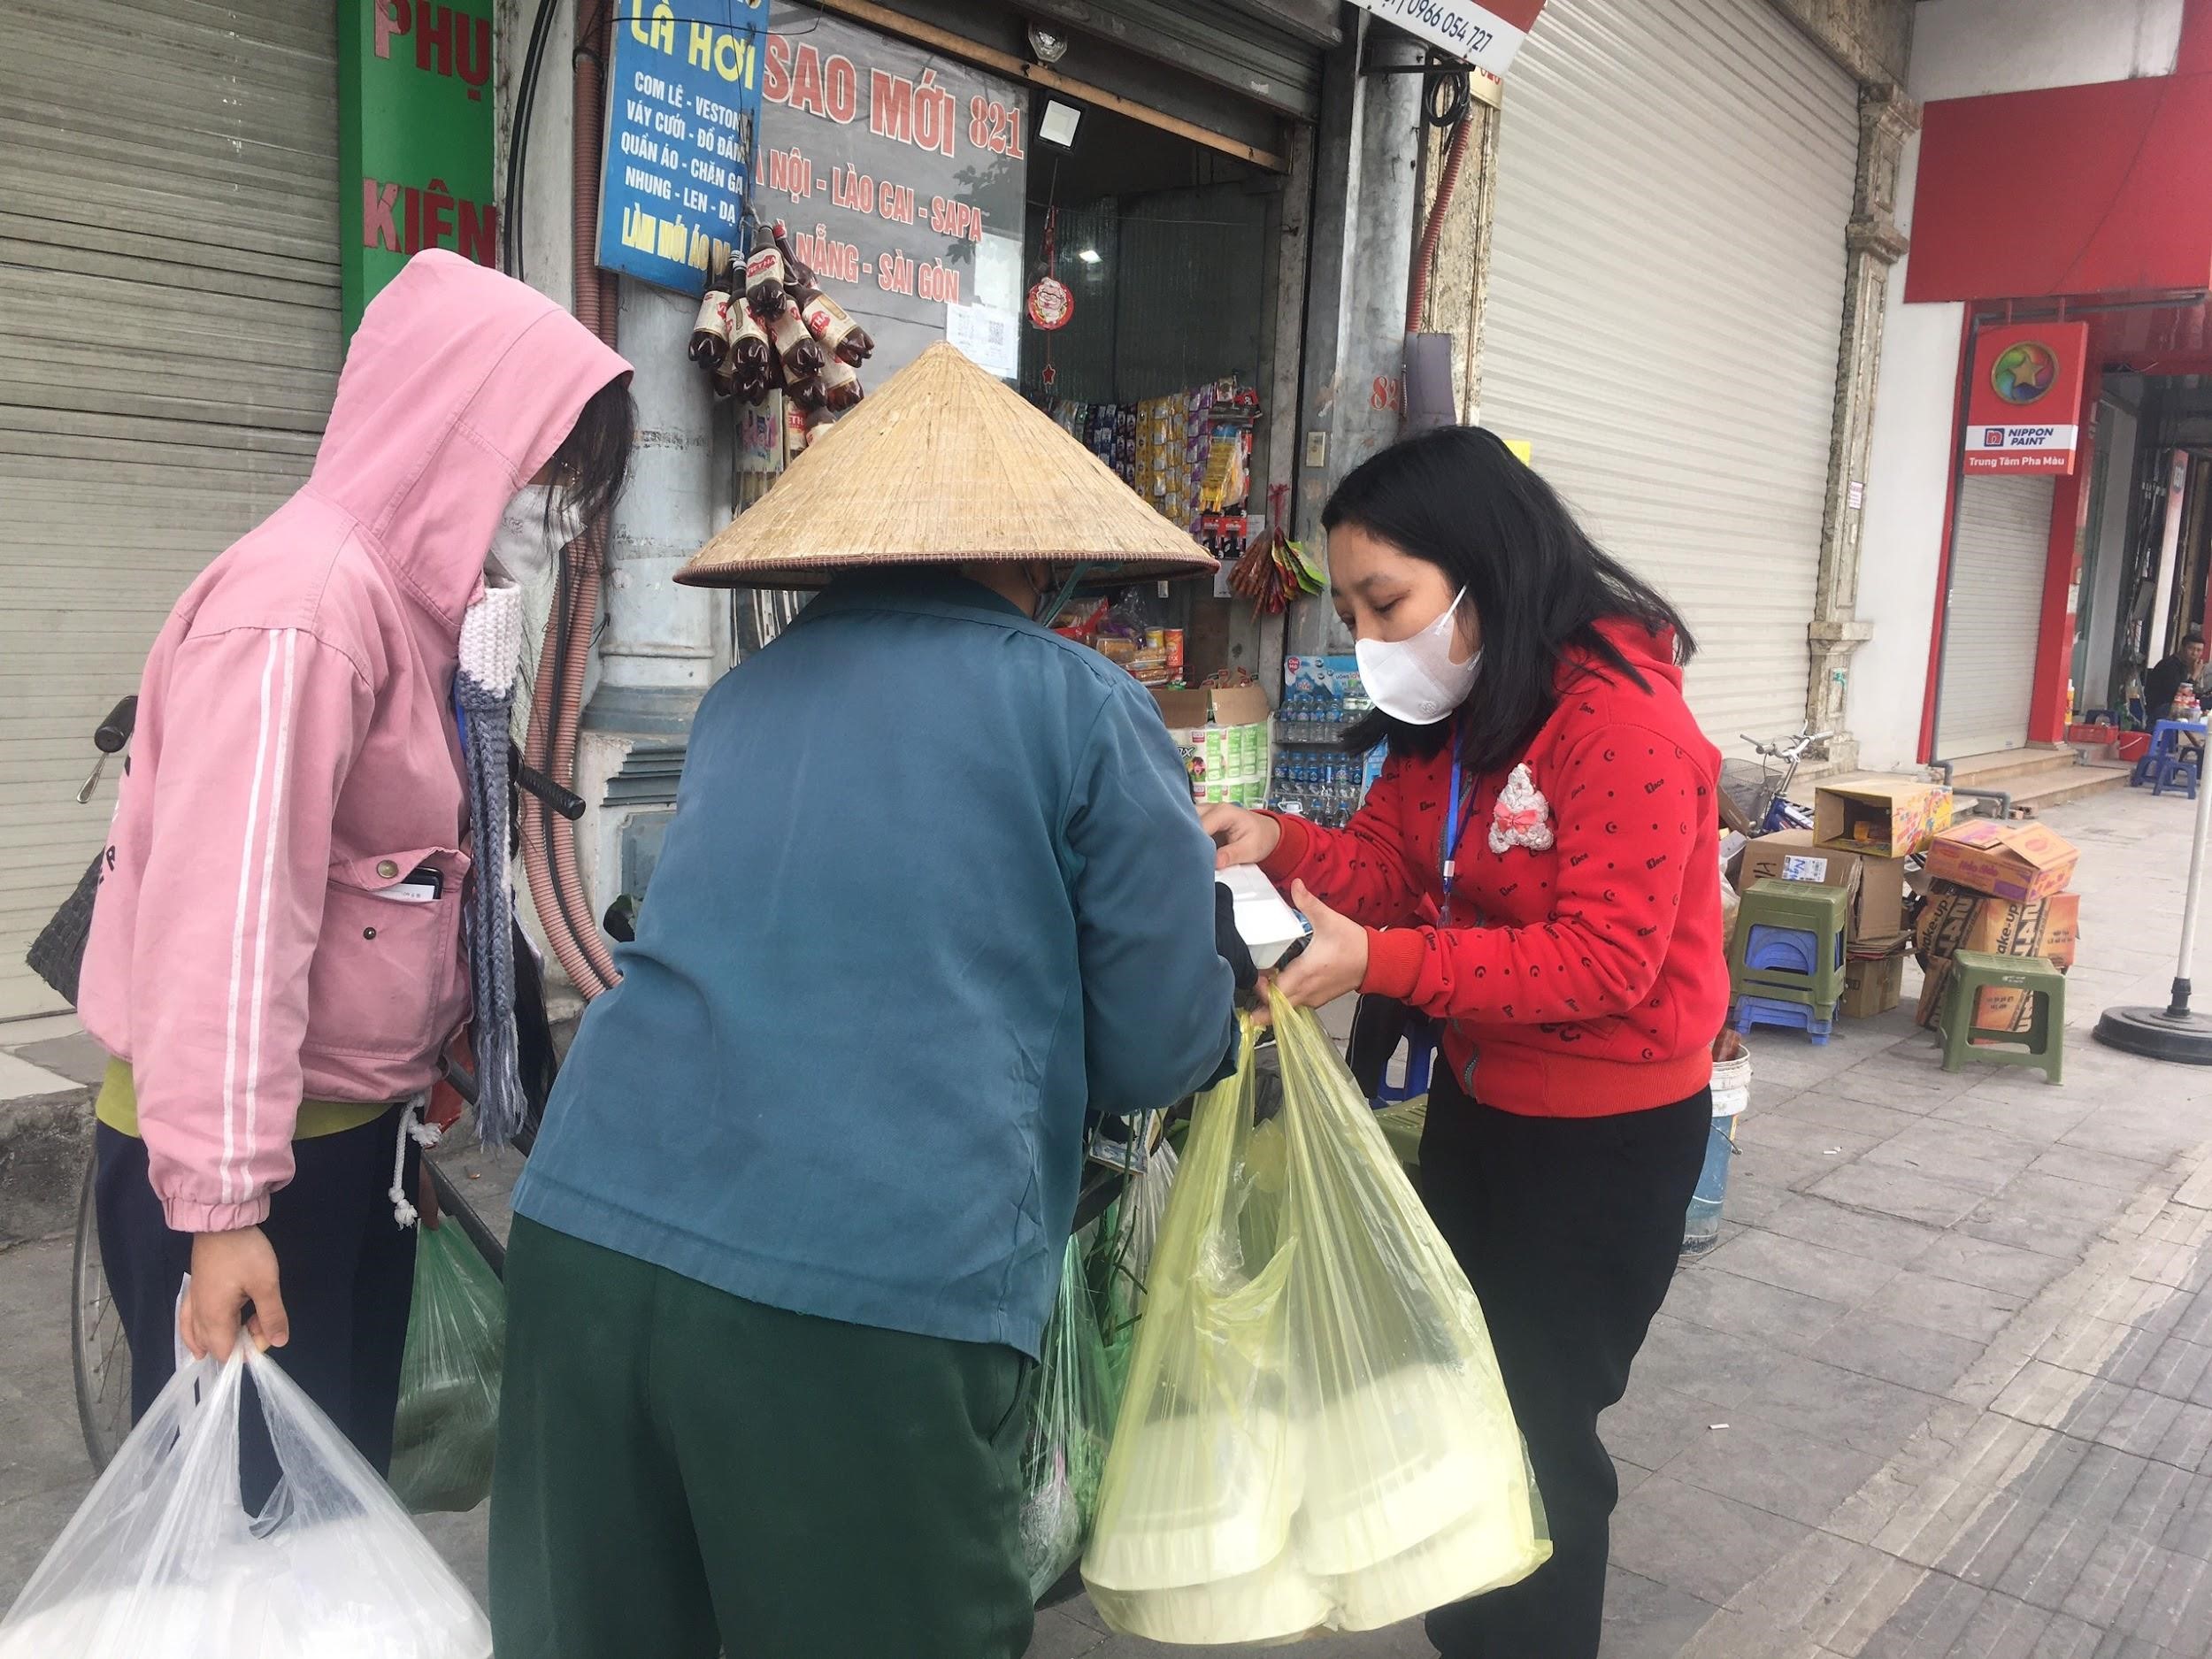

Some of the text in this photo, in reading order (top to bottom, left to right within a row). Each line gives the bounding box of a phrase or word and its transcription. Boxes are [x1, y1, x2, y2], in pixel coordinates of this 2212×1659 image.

[373, 0, 490, 101] PHỤ
[687, 19, 756, 90] HƠI
[1441, 12, 1470, 42] 054
[1466, 26, 1494, 53] 727
[634, 71, 664, 101] COM
[668, 84, 684, 109] LÊ
[762, 32, 1025, 160] SAO MỚI 821
[626, 98, 653, 127] VÁY
[655, 113, 686, 141] CƯỚI
[697, 126, 715, 152] ĐỒ
[621, 131, 658, 163] QUẦN
[660, 143, 679, 171] ÁO
[690, 157, 725, 188] CHĂN
[625, 165, 672, 200] NHUNG
[683, 188, 708, 213] LEN
[718, 200, 736, 227] DẠ
[770, 147, 811, 204] NỘI
[832, 162, 874, 215] LÀO
[879, 180, 914, 226] CAI
[931, 196, 983, 242] SAPA
[622, 202, 657, 254] LÀM
[657, 214, 687, 265] MỚI
[688, 224, 710, 272] ÁO
[878, 249, 914, 296] SÀI
[918, 257, 961, 305] GÒN
[2008, 428, 2054, 437] NIPPON
[2010, 437, 2045, 446] PAINT
[1970, 457, 1997, 467] Trung
[2022, 457, 2041, 465] Pha
[1995, 904, 2020, 956] ake-up
